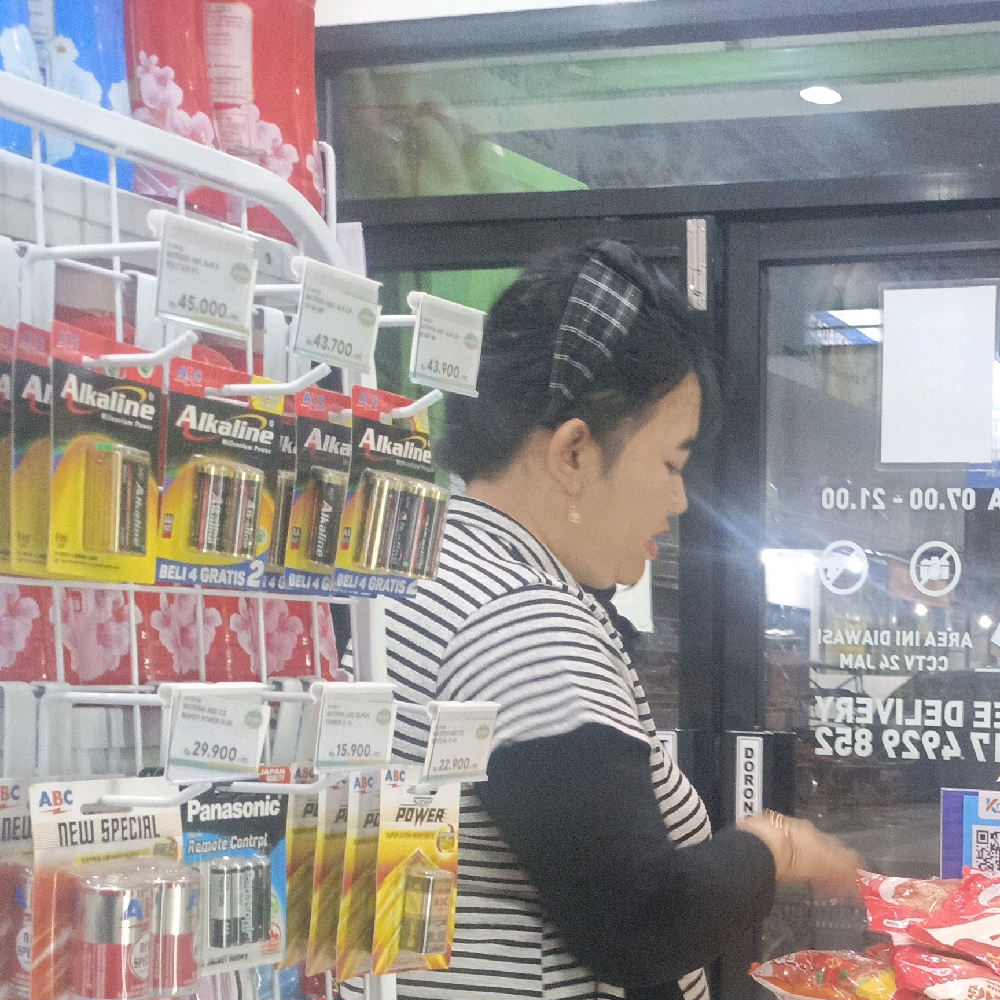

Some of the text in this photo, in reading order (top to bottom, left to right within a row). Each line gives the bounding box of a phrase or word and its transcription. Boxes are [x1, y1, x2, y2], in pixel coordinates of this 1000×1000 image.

[178, 294, 227, 318] 45.000
[313, 333, 352, 357] 43.700
[427, 359, 460, 379] 43.900
[60, 373, 155, 420] Alkaline
[175, 404, 274, 444] Alkaline
[358, 427, 432, 463] Alkaline
[315, 500, 333, 558] Alkaline
[159, 559, 265, 587] BELI 4 GRATIS 2
[288, 575, 311, 590] BELI
[312, 577, 320, 590] 4
[336, 574, 357, 588] BELI
[359, 575, 367, 588] 4
[368, 576, 407, 594] GRATIS
[193, 740, 238, 762] 29.900
[336, 743, 371, 758] 15.900
[260, 768, 286, 776] JAPAN
[385, 769, 406, 782] ABC
[439, 758, 470, 772] 22.900
[0, 785, 20, 800] BC
[354, 776, 374, 789] ABC
[743, 747, 754, 818] DORON
[39, 789, 74, 808] ABC
[187, 794, 280, 823] Panasonic
[395, 807, 447, 827] POWER
[58, 815, 161, 848] NEW SPECIAL
[188, 832, 268, 854] Remote Control
